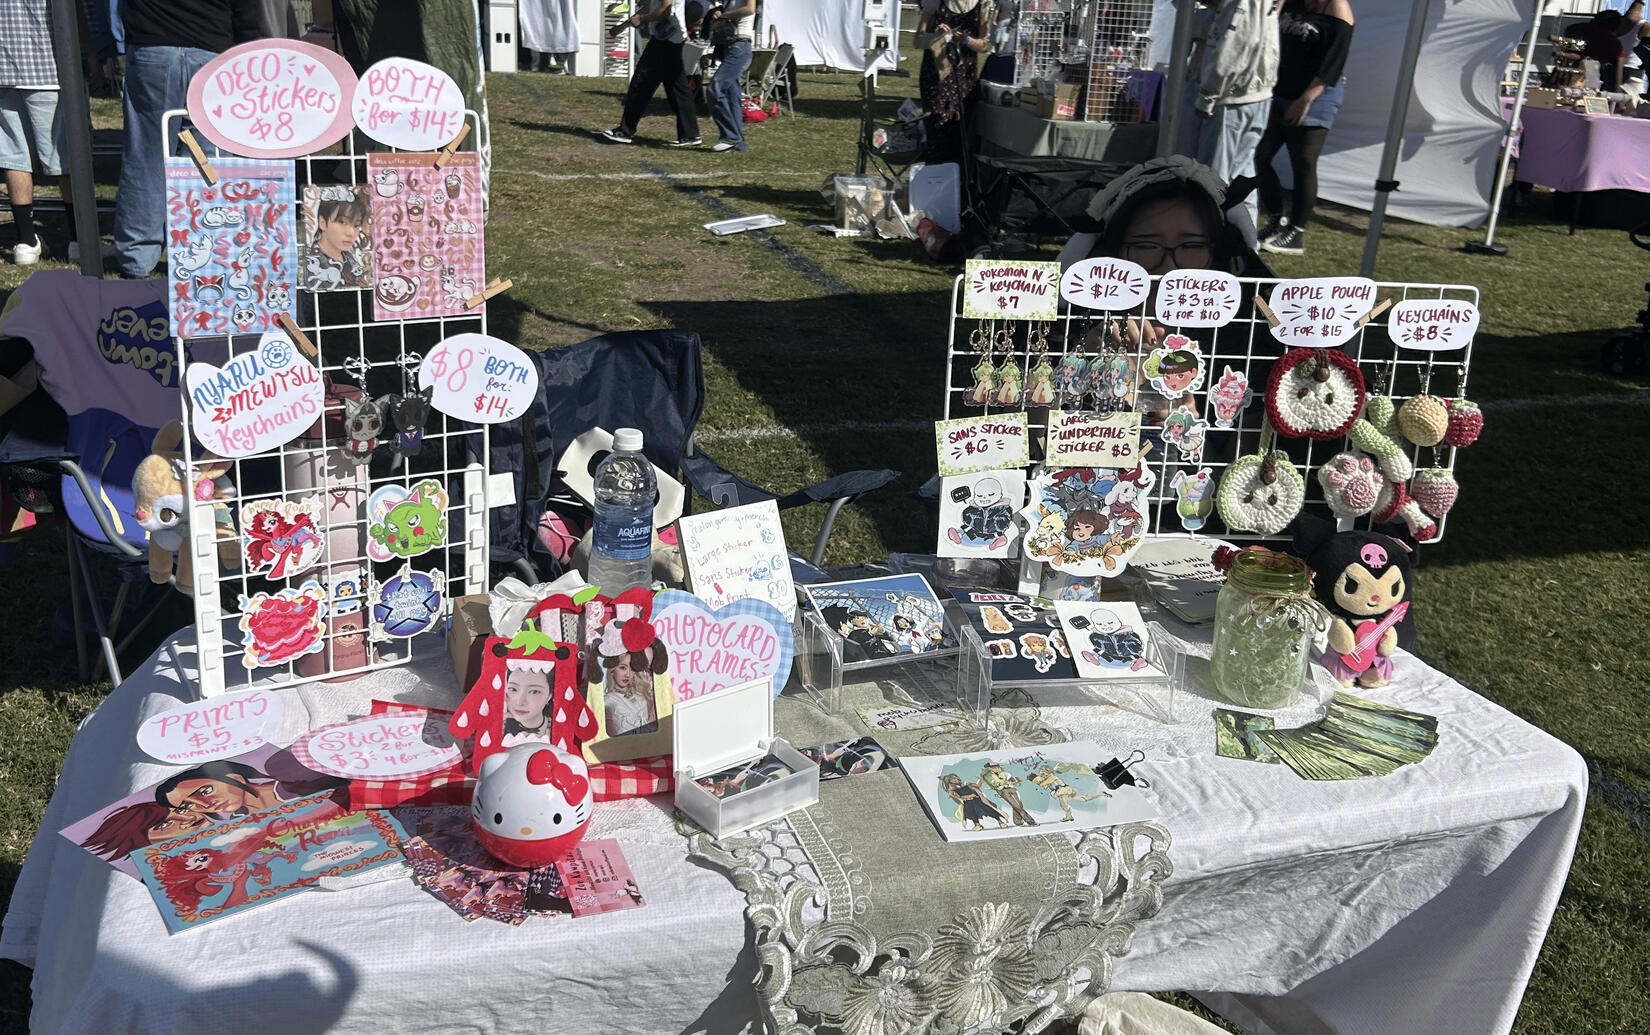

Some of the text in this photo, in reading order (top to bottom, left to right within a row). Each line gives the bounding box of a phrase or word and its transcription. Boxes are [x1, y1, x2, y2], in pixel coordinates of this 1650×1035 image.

[215, 53, 280, 96] DECO
[368, 65, 445, 106] BOTH
[230, 76, 336, 120] Stickers
[249, 112, 294, 142] $8
[368, 102, 447, 141] for $14
[980, 267, 1046, 281] POKEMON N
[1090, 264, 1130, 284] MIKU
[989, 280, 1048, 296] KEYCHAIN
[1090, 283, 1119, 299] $12
[1165, 276, 1228, 293] STICKERS
[1281, 284, 1371, 301] APPLE POUCH
[997, 296, 1019, 310] $7
[1178, 293, 1200, 306] $3
[1162, 309, 1220, 321] 4 FOR $10
[1307, 305, 1335, 321] $10
[1396, 304, 1473, 326] KEYCHAINS
[1279, 325, 1343, 338] 2 FOR $15
[1412, 325, 1440, 343] $8
[430, 346, 474, 393] $8
[484, 356, 529, 384] BOTH
[193, 354, 265, 414] NYARU
[228, 365, 319, 416] MEWTSU
[474, 393, 508, 418] $14
[215, 393, 317, 455] Keychains
[1061, 415, 1090, 427] LARGE
[948, 423, 1022, 444] SANS STICKER
[1058, 427, 1126, 441] UNDERTALE
[964, 438, 989, 456] $6
[1057, 441, 1131, 458] STICKER $8
[699, 571, 723, 586] Sans
[151, 692, 268, 737] PRINTS
[187, 726, 232, 748] $5
[318, 722, 440, 752] Stickers
[166, 745, 228, 760] MISPRINT
[329, 750, 370, 770] $3
[385, 756, 396, 766] 4
[400, 752, 419, 764] for
